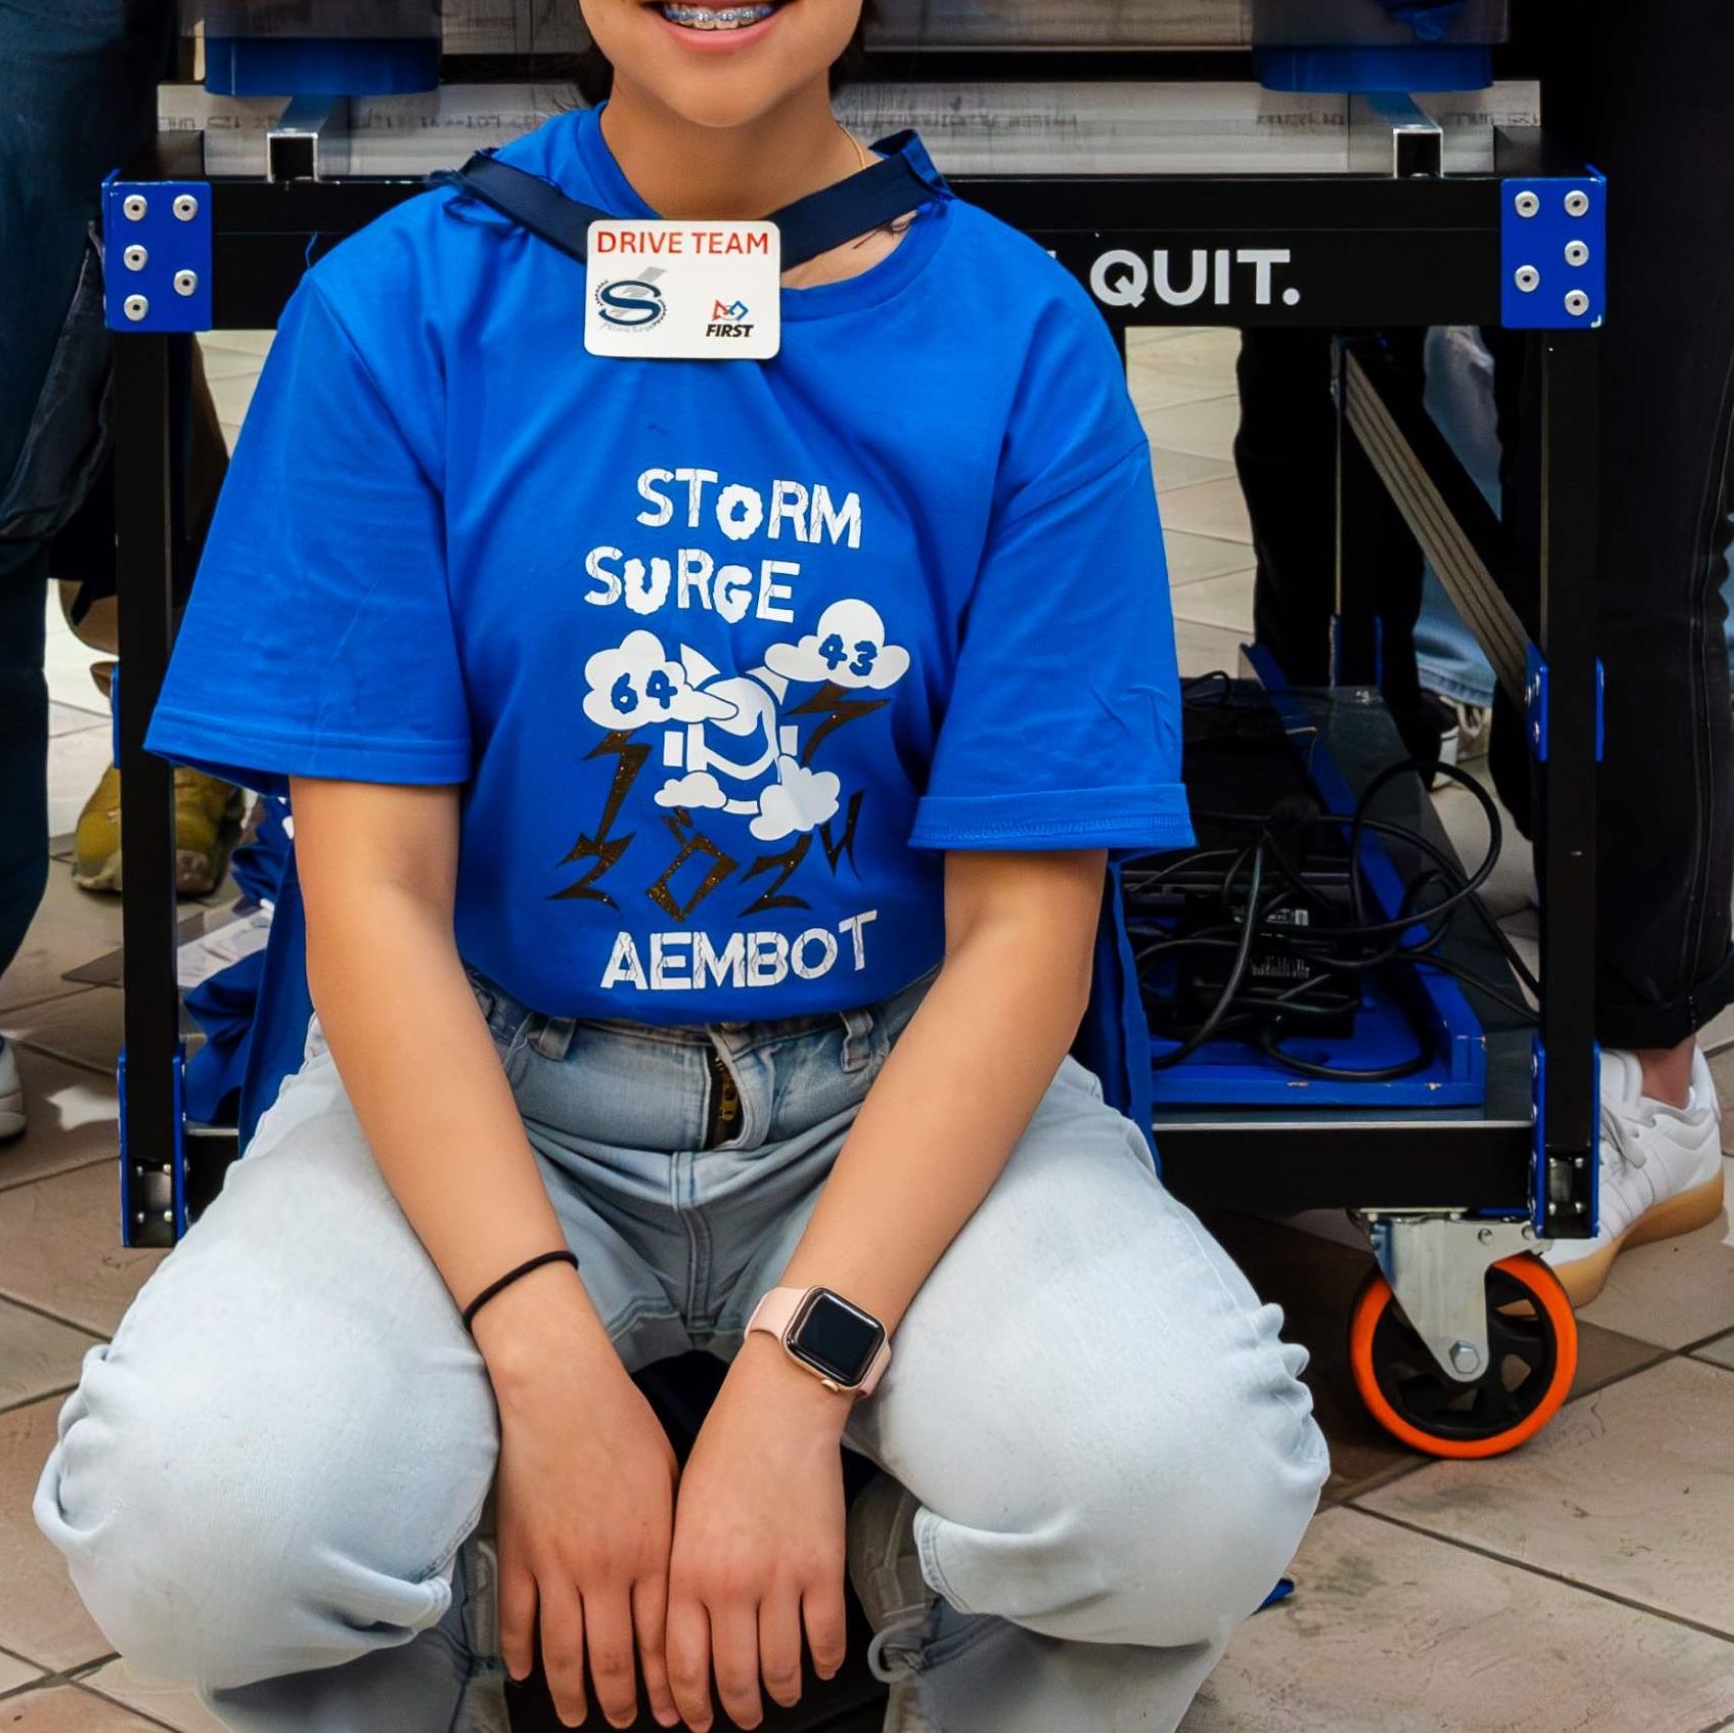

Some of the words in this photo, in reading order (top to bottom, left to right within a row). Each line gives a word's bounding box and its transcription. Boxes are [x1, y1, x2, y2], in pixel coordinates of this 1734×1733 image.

[597, 231, 683, 254] DRIVE
[691, 232, 769, 255] TEAM
[1089, 249, 1301, 308] QUIT.
[705, 323, 755, 338] FIRST
[636, 468, 862, 549] STORM
[583, 545, 801, 624] SURGE
[819, 633, 880, 677] 43
[611, 669, 678, 713] 64
[600, 910, 878, 990] AEMBOT
